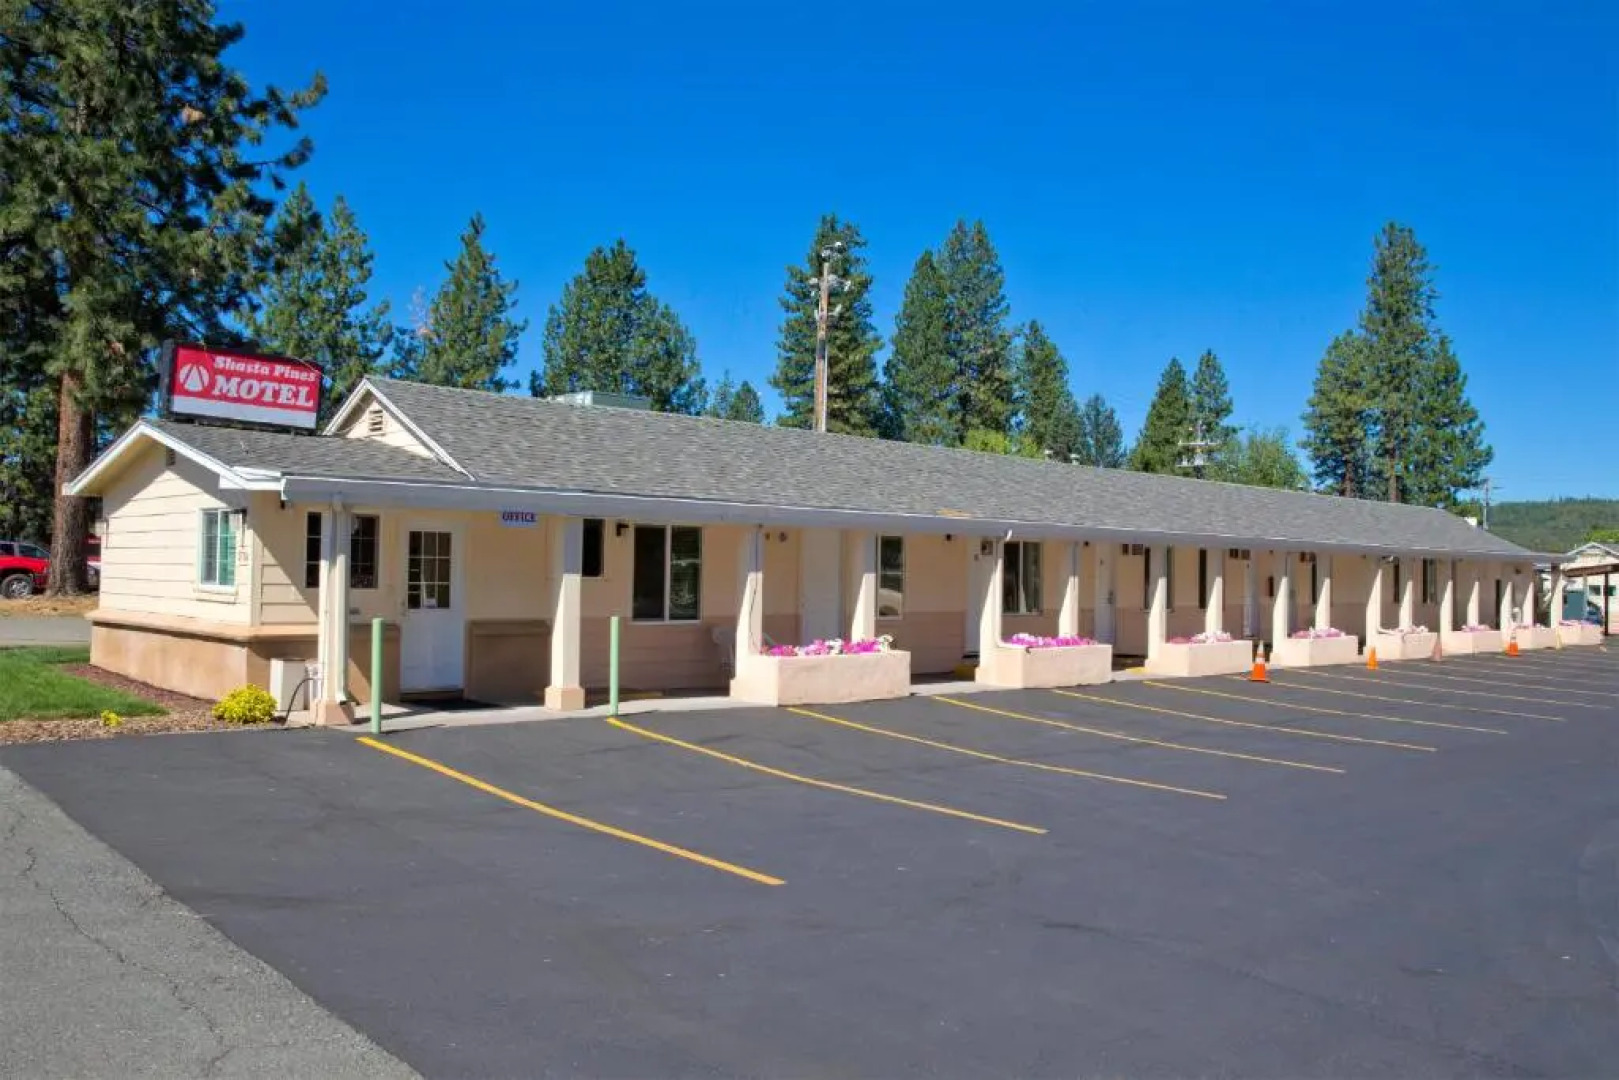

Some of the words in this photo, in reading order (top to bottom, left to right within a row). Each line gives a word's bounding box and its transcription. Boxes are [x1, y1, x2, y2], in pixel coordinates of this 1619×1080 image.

[214, 355, 270, 375] Shasta
[273, 364, 316, 382] Pines
[212, 374, 314, 407] MOTEL
[502, 511, 536, 522] OFFICE
